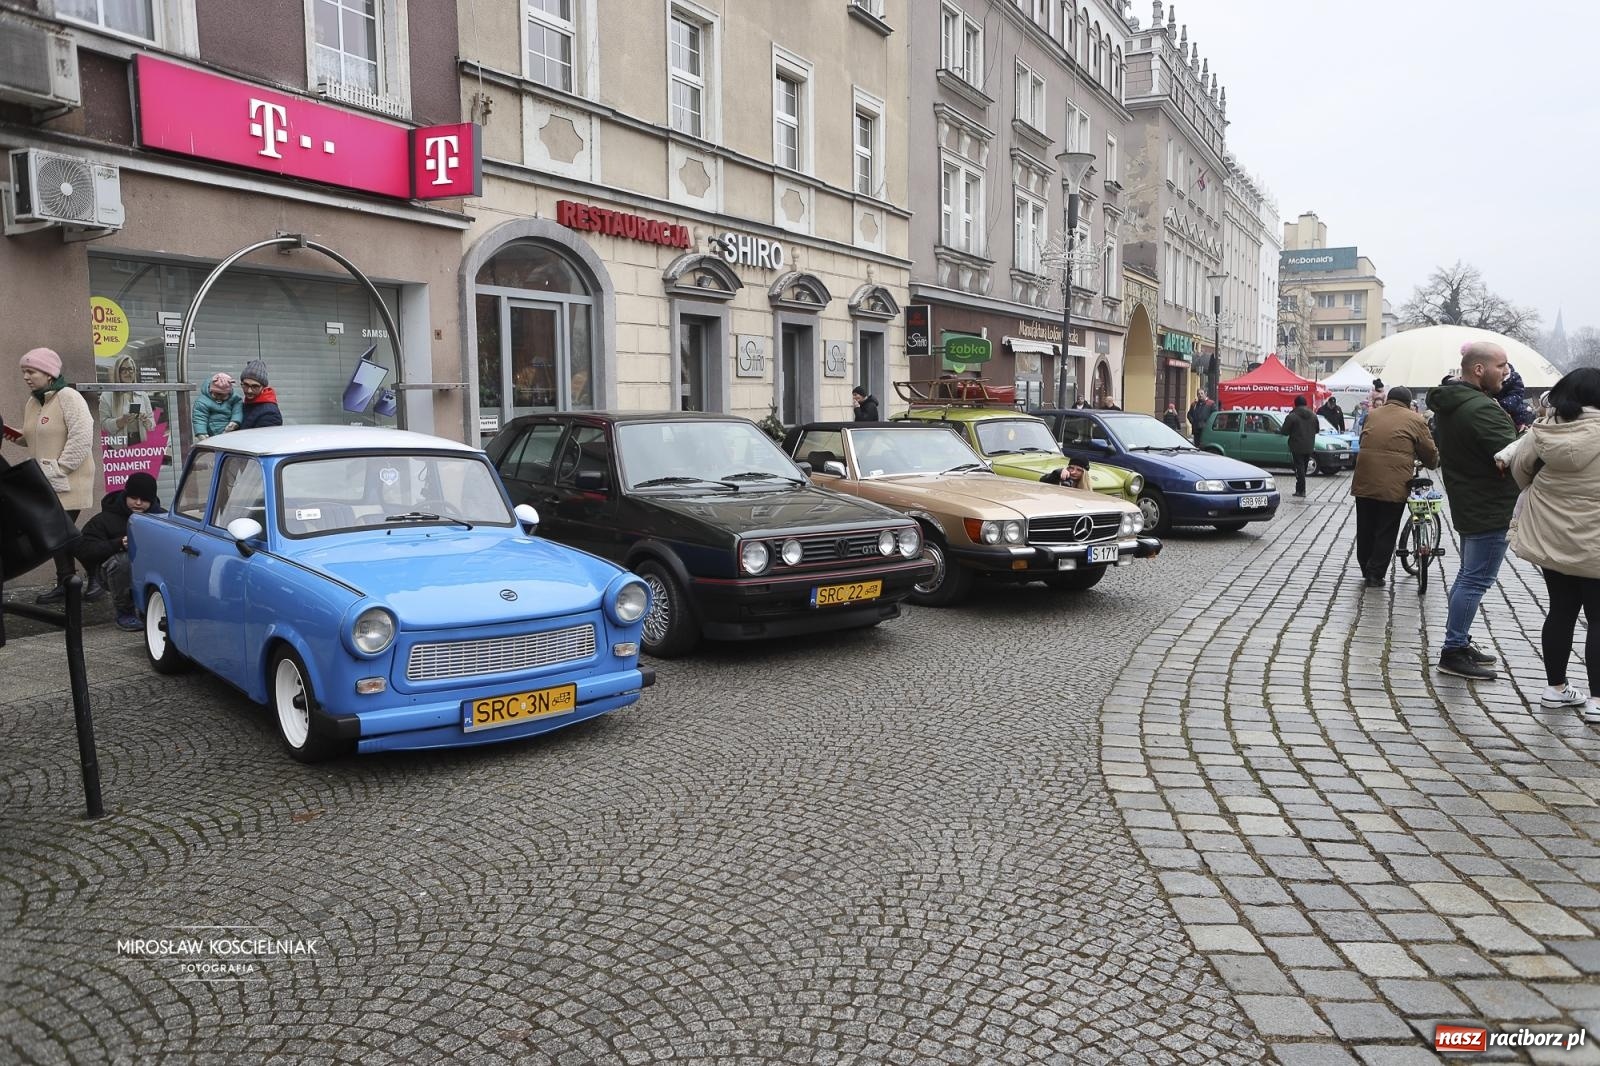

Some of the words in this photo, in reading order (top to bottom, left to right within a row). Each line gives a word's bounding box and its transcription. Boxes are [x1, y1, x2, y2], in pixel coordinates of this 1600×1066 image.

[425, 135, 459, 185] T
[557, 200, 692, 250] RESTAURACJA
[722, 232, 784, 270] SHIRO
[1288, 256, 1334, 265] McDonald's
[91, 306, 105, 323] 0
[950, 343, 986, 354] żabka
[1093, 548, 1098, 560] S
[1101, 547, 1117, 560] 17Y
[819, 586, 845, 603] SRC
[847, 584, 863, 600] 22
[477, 697, 519, 723] SRC
[526, 691, 550, 714] 3N
